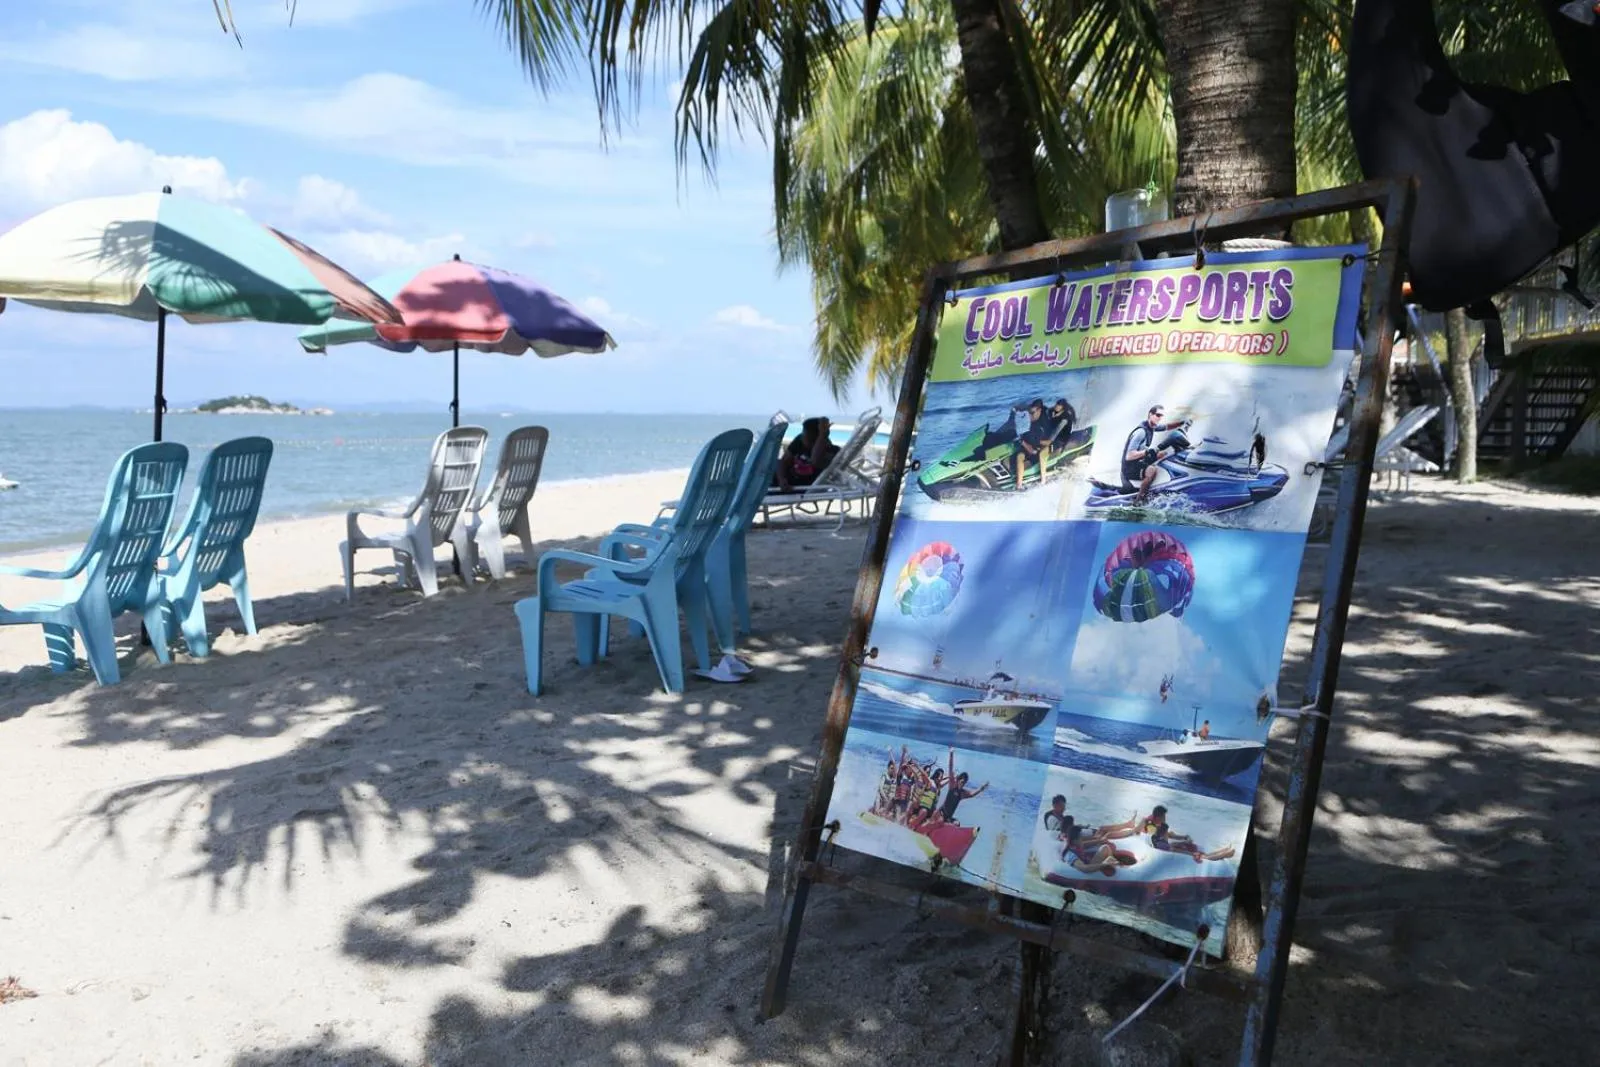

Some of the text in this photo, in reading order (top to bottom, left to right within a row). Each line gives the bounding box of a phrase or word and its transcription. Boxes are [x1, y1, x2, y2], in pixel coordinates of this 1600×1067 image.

[963, 268, 1295, 345] COOL WATERSPORTS
[1009, 341, 1071, 367] رياضة
